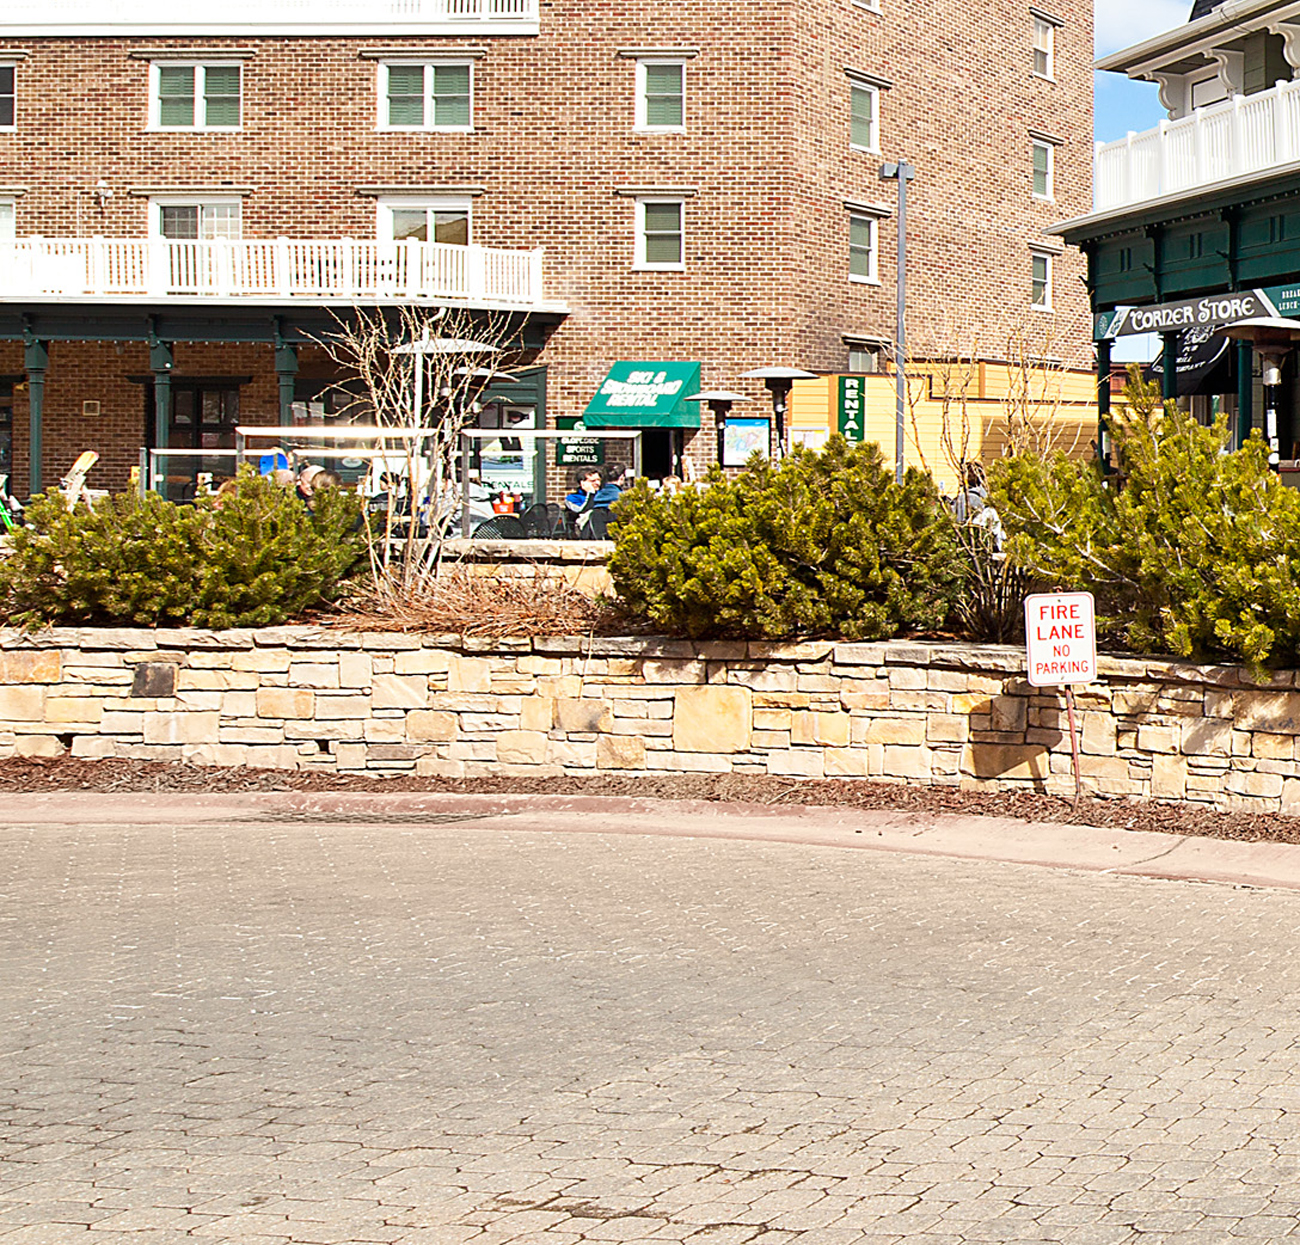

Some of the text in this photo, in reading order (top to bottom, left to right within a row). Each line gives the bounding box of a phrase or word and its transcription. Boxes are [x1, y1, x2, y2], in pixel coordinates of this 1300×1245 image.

[1198, 297, 1256, 323] STORE
[627, 371, 667, 384] SKI &
[600, 379, 683, 395] SNOWBOARD
[606, 393, 658, 407] RENTAL
[566, 445, 594, 454] SPORTS
[562, 454, 598, 463] RENTALS
[1040, 604, 1080, 620] FIRE
[1037, 624, 1085, 640] LANE
[1053, 644, 1070, 657] NO
[1036, 660, 1089, 674] PARKING
